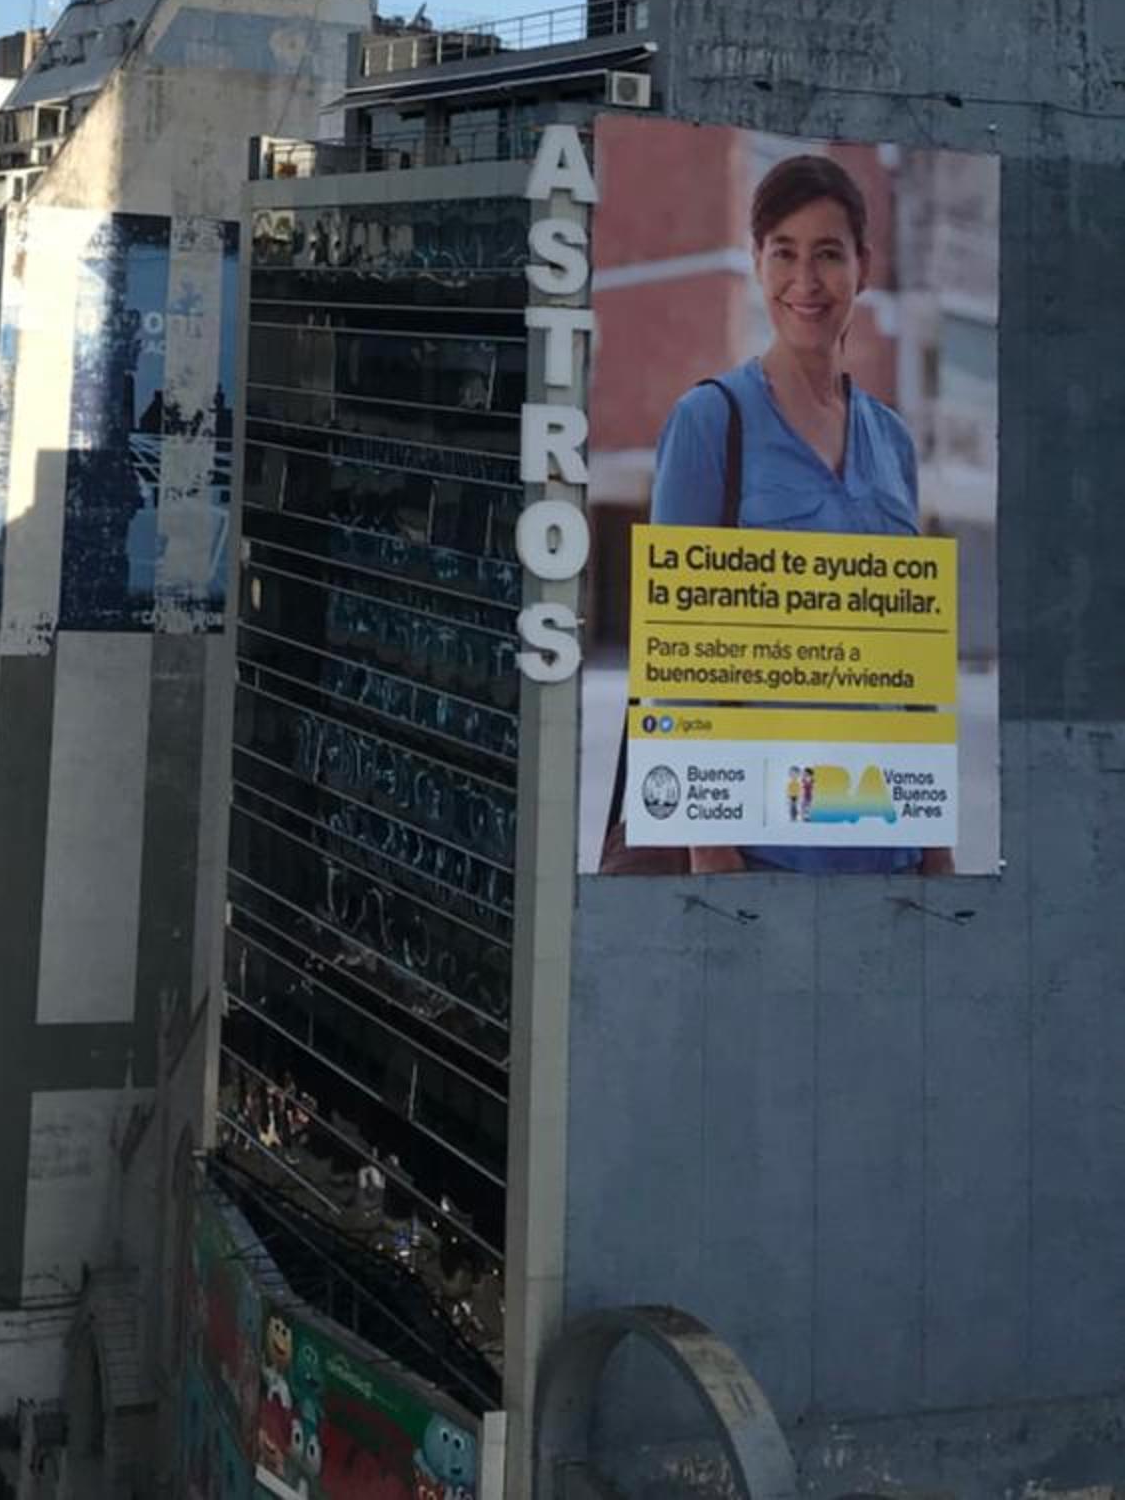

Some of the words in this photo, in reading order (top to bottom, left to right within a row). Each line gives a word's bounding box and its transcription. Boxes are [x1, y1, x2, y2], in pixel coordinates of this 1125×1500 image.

[515, 124, 600, 683] ASTROS
[649, 544, 678, 569] La
[686, 545, 775, 573] Ciudad
[783, 550, 807, 574] te
[813, 553, 887, 580] ayuda
[893, 559, 937, 579] con
[648, 579, 668, 605] la
[676, 582, 780, 610] garantía
[786, 590, 841, 613] para
[847, 588, 941, 616] alquilar.
[647, 637, 690, 657] Para
[695, 639, 746, 659] saber
[752, 640, 792, 660] más
[797, 641, 844, 662] entrá
[849, 648, 861, 662] a
[646, 663, 914, 689] buenosaires.gob.ar/vivienda
[687, 765, 745, 782] Buenos
[883, 770, 934, 785] Vamos
[686, 785, 730, 801] Aires
[893, 786, 947, 802] Buenos
[686, 803, 743, 820] Ciudad
[902, 803, 943, 818] Aires
